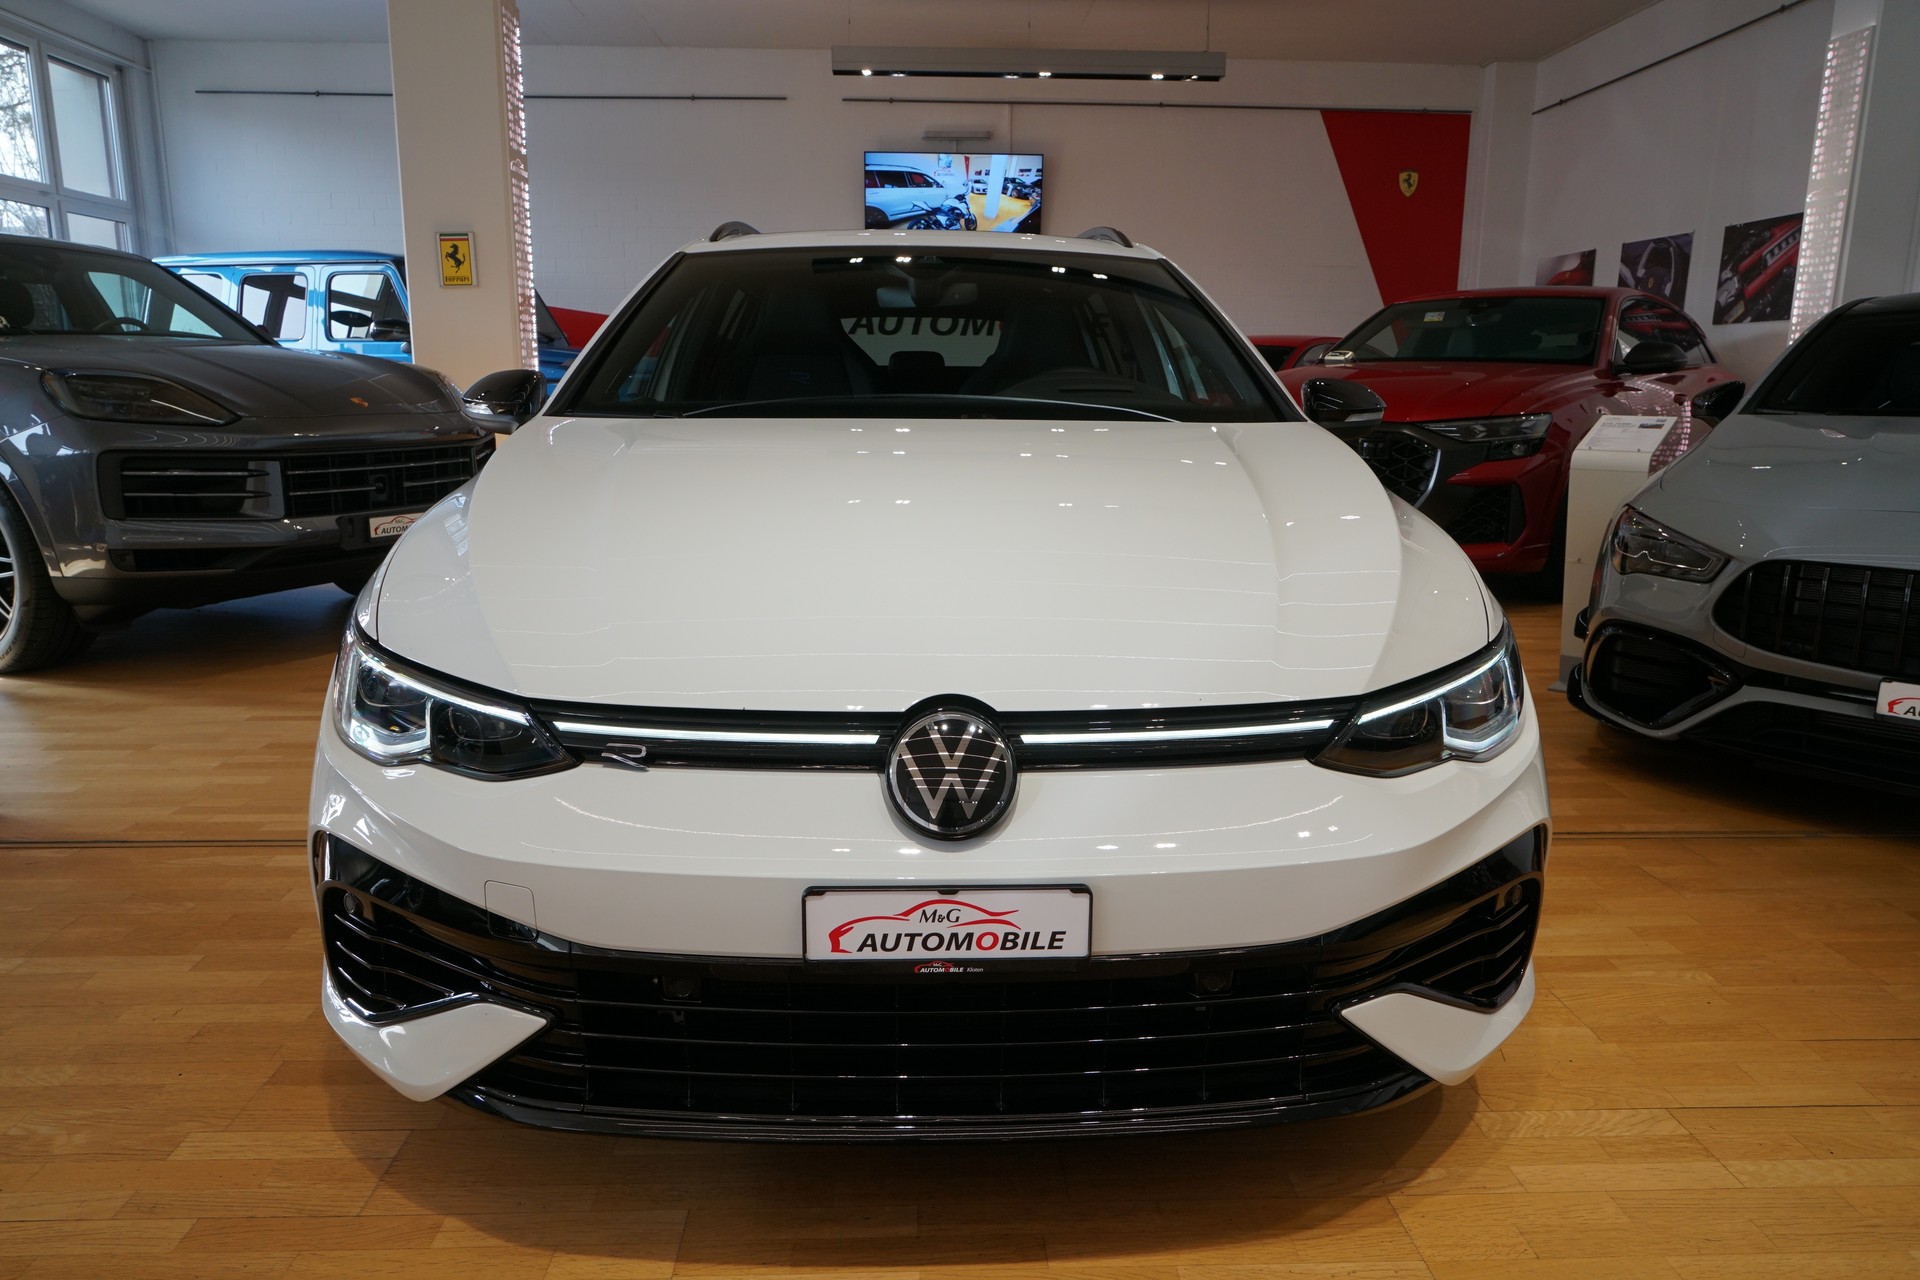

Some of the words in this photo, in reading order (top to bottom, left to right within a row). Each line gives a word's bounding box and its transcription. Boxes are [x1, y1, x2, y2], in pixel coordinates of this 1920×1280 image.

[848, 316, 1004, 336] AUTOM
[919, 908, 961, 924] M&G
[856, 930, 1067, 953] AUTOMOBILE
